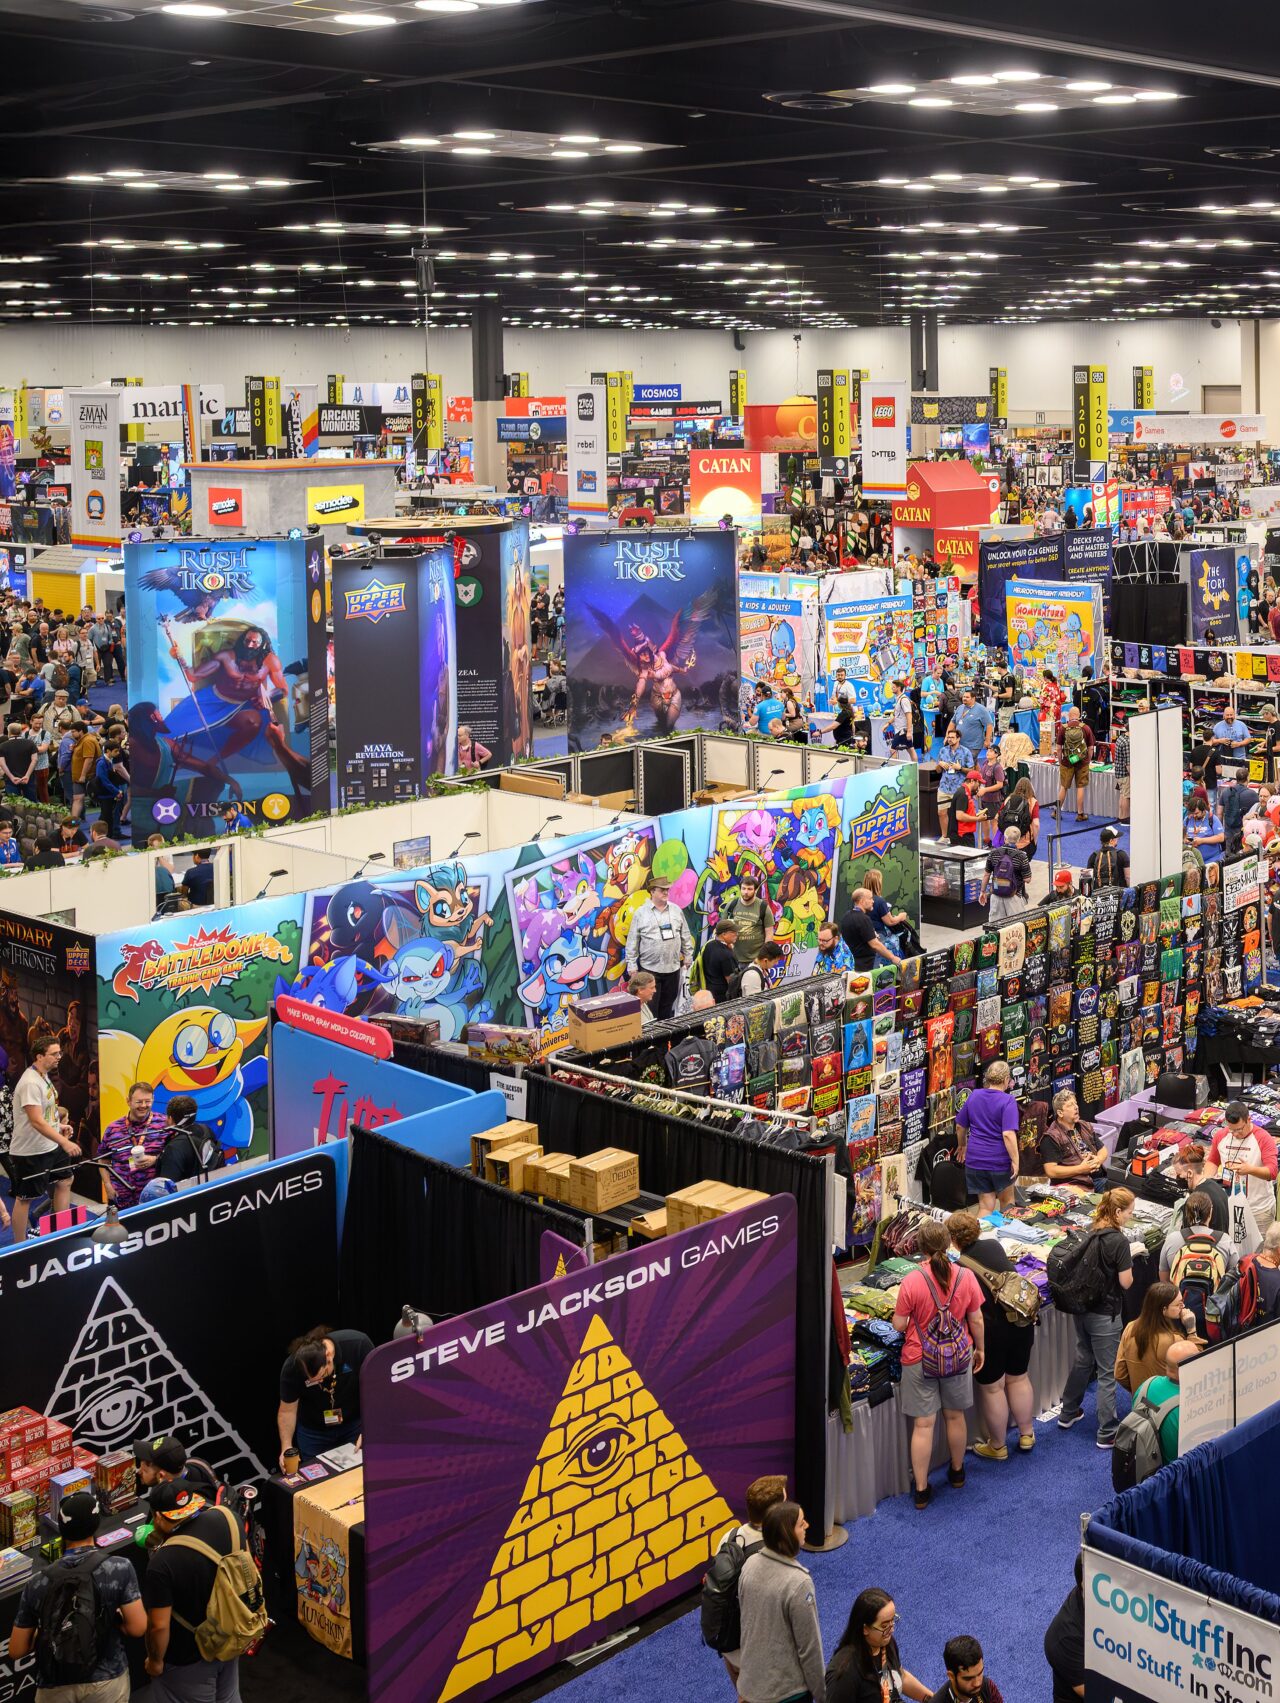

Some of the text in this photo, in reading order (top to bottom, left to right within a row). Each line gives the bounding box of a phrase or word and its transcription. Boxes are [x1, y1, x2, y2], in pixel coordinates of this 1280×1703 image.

[641, 388, 679, 398] KOSMOS
[321, 410, 360, 420] ARCANE
[874, 406, 893, 418] LEGO
[321, 421, 360, 432] WONDERS
[822, 396, 830, 446] 1100
[577, 440, 595, 450] rebel
[699, 458, 752, 474] CATAN
[314, 496, 353, 511] asmodee
[895, 507, 930, 522] CATAN
[616, 539, 680, 561] RUSH
[937, 540, 974, 555] CATAN
[988, 545, 1058, 560] UNLOCK YOUR GENIUS
[1085, 543, 1110, 552] MASTERS
[178, 549, 247, 570] RUSH
[1070, 551, 1108, 560] AND WRITERS
[1208, 567, 1220, 576] THE
[350, 590, 400, 604] UPPER
[746, 602, 759, 610] KIDS
[768, 604, 791, 612] ADULTS!
[839, 656, 860, 666] NEW
[356, 751, 404, 759] REVELATION
[187, 802, 256, 818] VISON
[856, 806, 906, 834] UPPER
[8, 942, 56, 975] THRONES
[143, 933, 268, 980] BATTLEDOME
[168, 963, 243, 988] TRADING CARD GAME
[286, 1006, 376, 1046] MAKE YOUR GRAY WORLD COLORFUL
[17, 1170, 323, 1289] JACKSON GAMES
[390, 1215, 780, 1383] STEVE JACKSON GAMES
[25, 1430, 46, 1442] BIG BOX
[40, 1470, 48, 1480] BIG
[50, 1464, 61, 1475] BOX
[301, 1600, 346, 1642] MUNCHKIN
[1092, 1573, 1272, 1680] CoolStuffInc
[1092, 1628, 1208, 1700] Cool Stuff. In
[1231, 1672, 1272, 1698] .com
